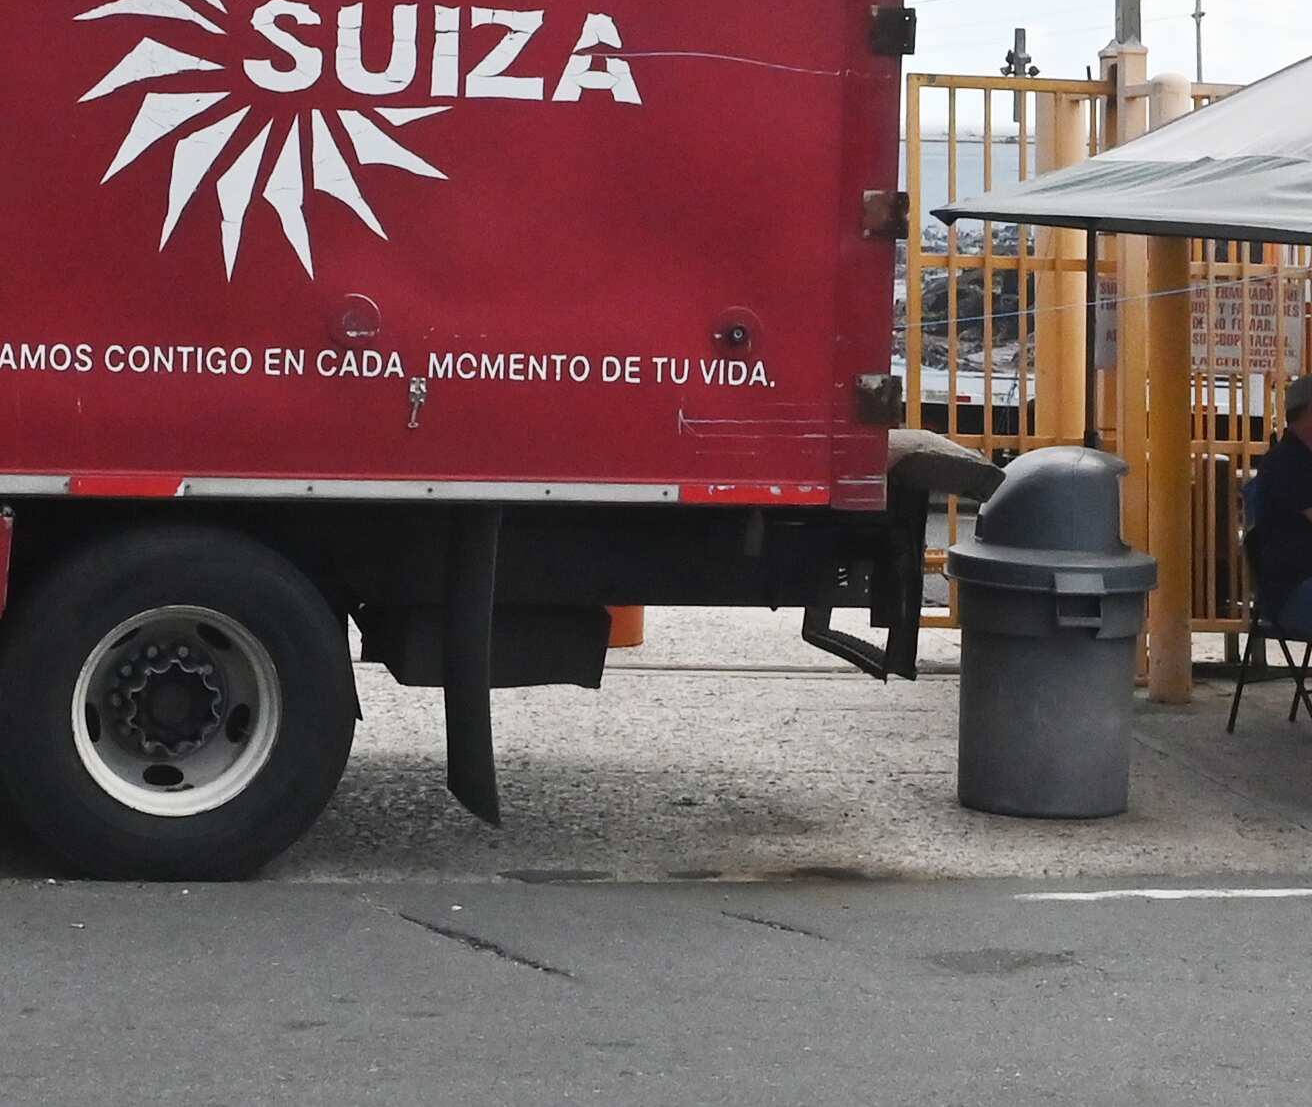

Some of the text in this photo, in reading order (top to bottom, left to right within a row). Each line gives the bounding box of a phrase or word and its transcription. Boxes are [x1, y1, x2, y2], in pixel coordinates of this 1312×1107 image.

[104, 344, 252, 375] CONTIGO
[264, 347, 305, 376] EN
[316, 349, 405, 378] CADA
[428, 352, 590, 382] MOMENTO
[602, 356, 641, 384] DE
[652, 357, 689, 385] TU
[699, 359, 776, 388] VIDA.
